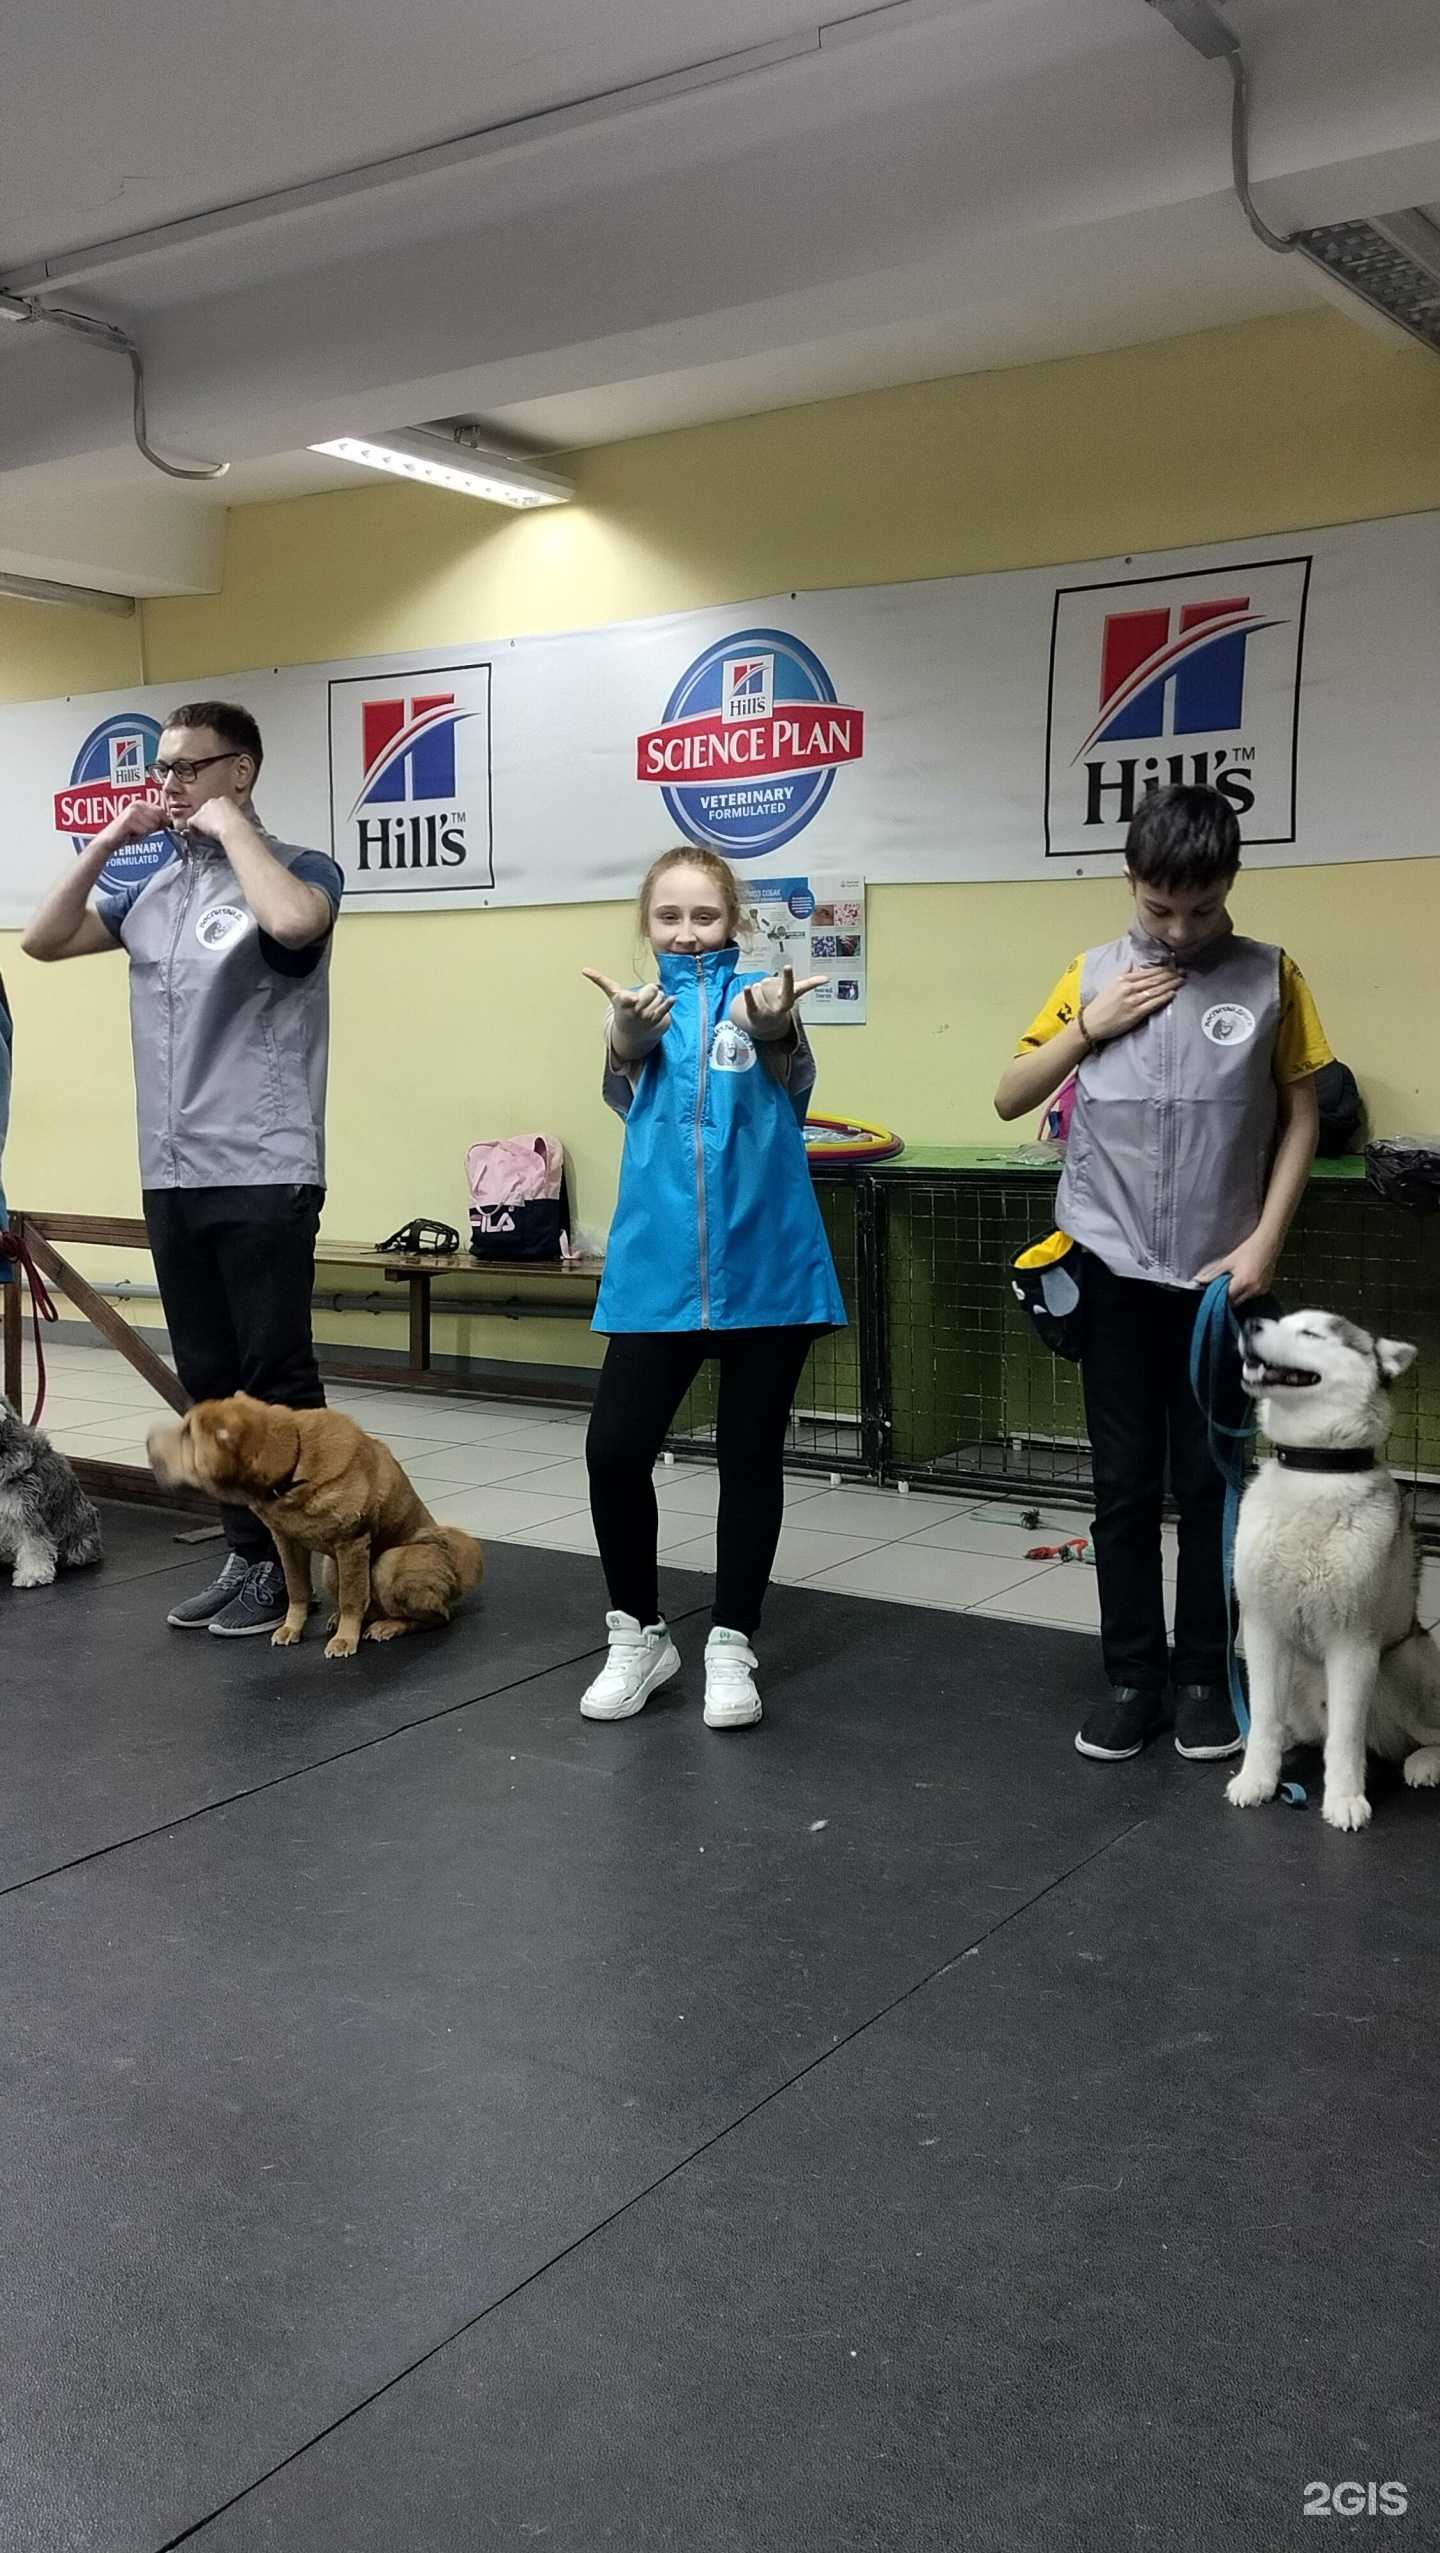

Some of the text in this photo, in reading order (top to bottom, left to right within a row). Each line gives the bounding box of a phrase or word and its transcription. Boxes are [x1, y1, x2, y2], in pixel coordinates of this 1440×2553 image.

[730, 697, 766, 716] Hill's
[646, 719, 851, 774] SCIENCE PLAN
[115, 767, 141, 784] Hill's
[700, 786, 795, 809] VETERINARY
[708, 802, 787, 821] FORMULATED
[113, 841, 164, 857] ERINARY
[356, 813, 467, 870] Hill's
